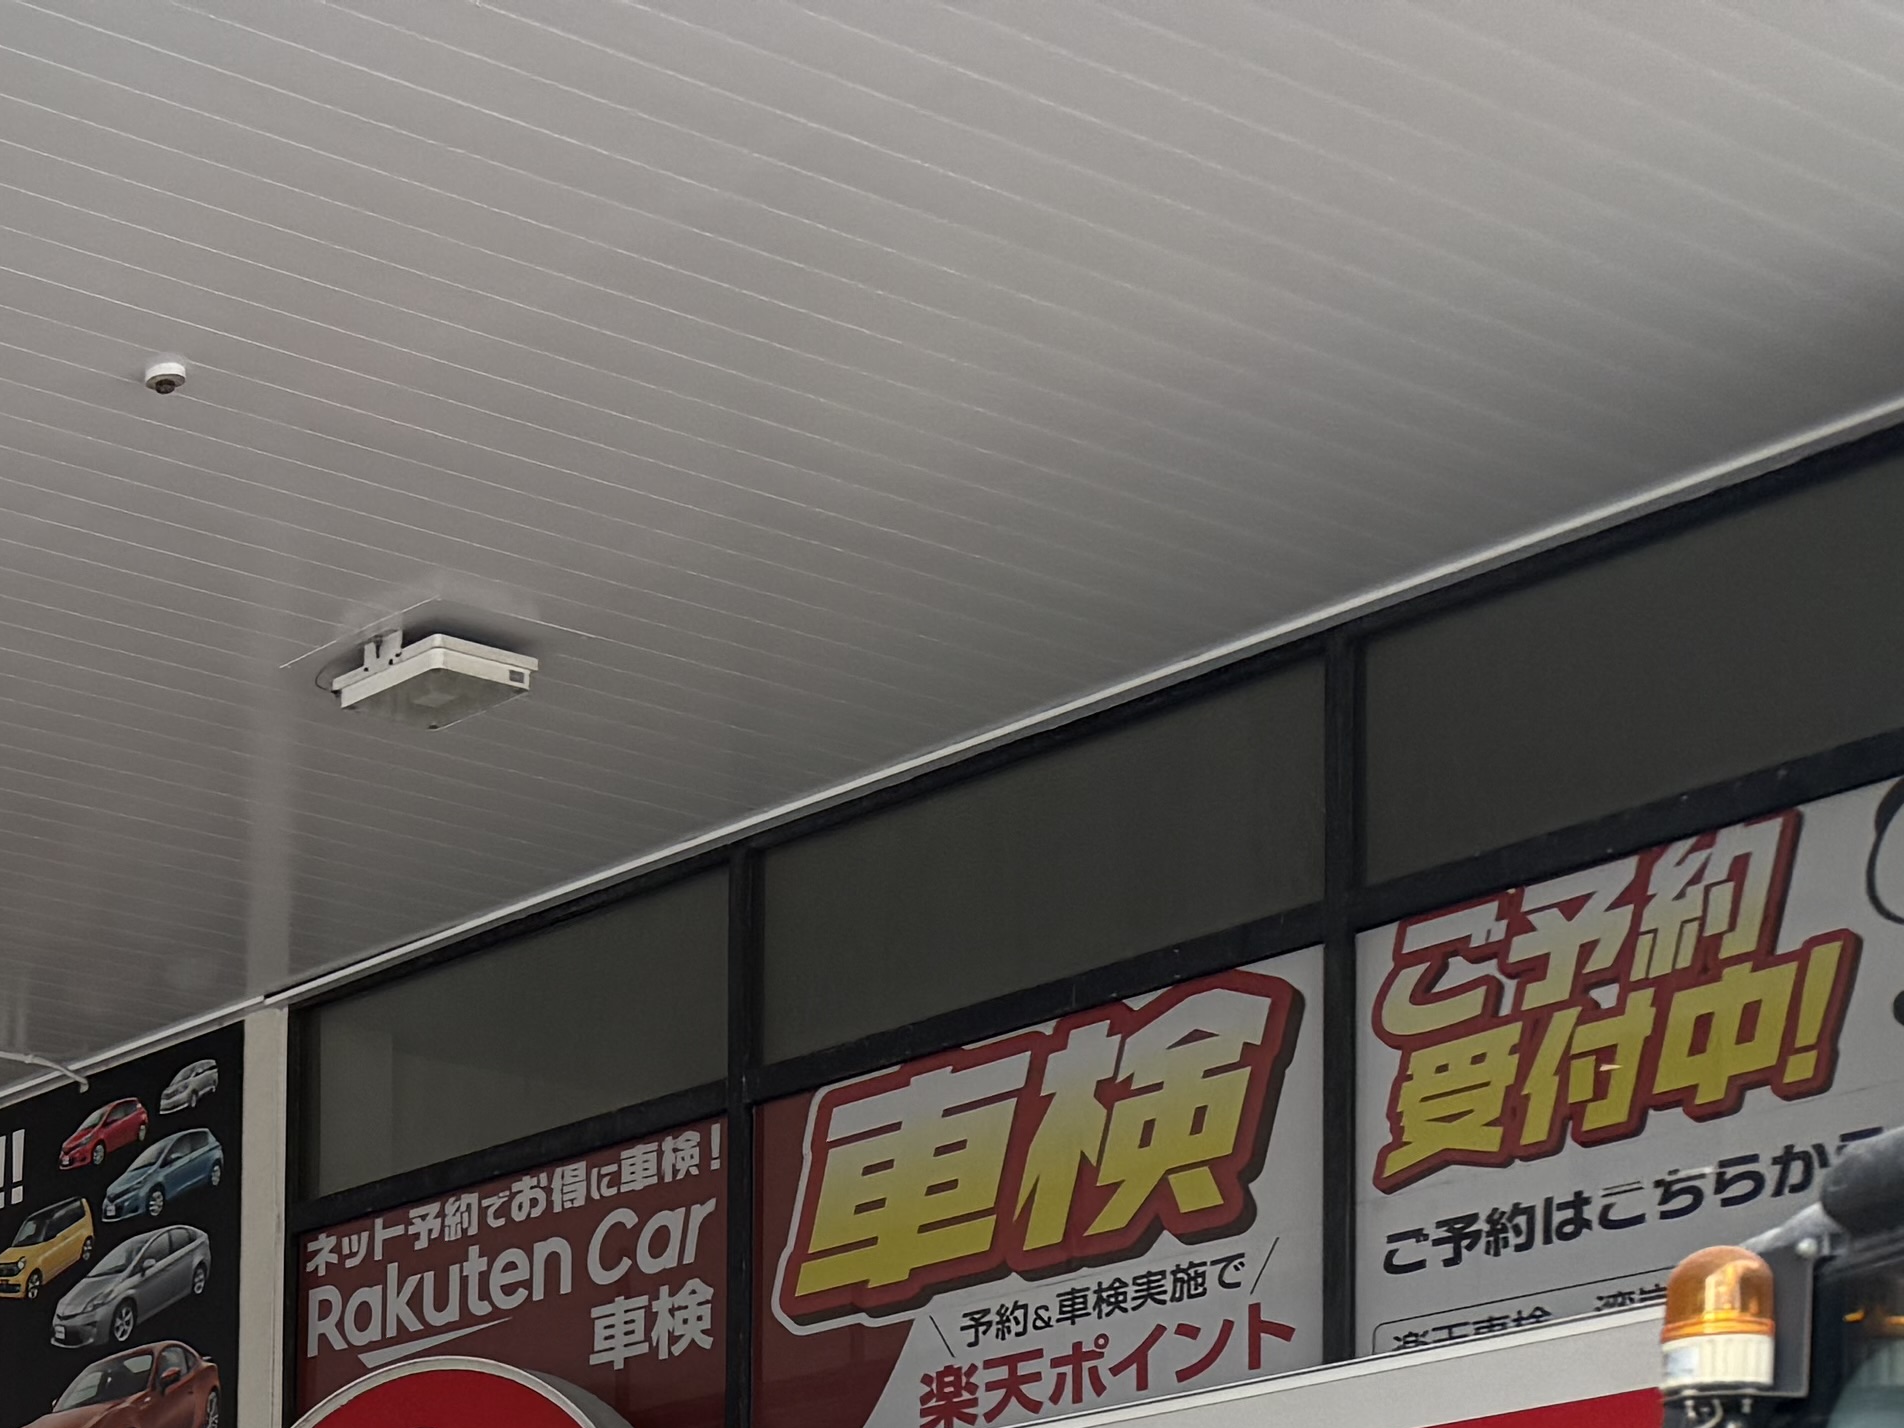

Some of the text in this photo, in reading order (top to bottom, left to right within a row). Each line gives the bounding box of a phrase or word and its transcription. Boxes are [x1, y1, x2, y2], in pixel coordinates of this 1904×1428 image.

[1382, 818, 1783, 1036] ご予約
[1380, 938, 1844, 1178] 受付中!
[306, 1123, 723, 1275] ネット予約でお得に車検!
[794, 986, 1272, 1297] 車検
[307, 1197, 717, 1359] Rakuten Car
[589, 1278, 715, 1370] 車検
[960, 1252, 1244, 1348] 予約&車検実施で
